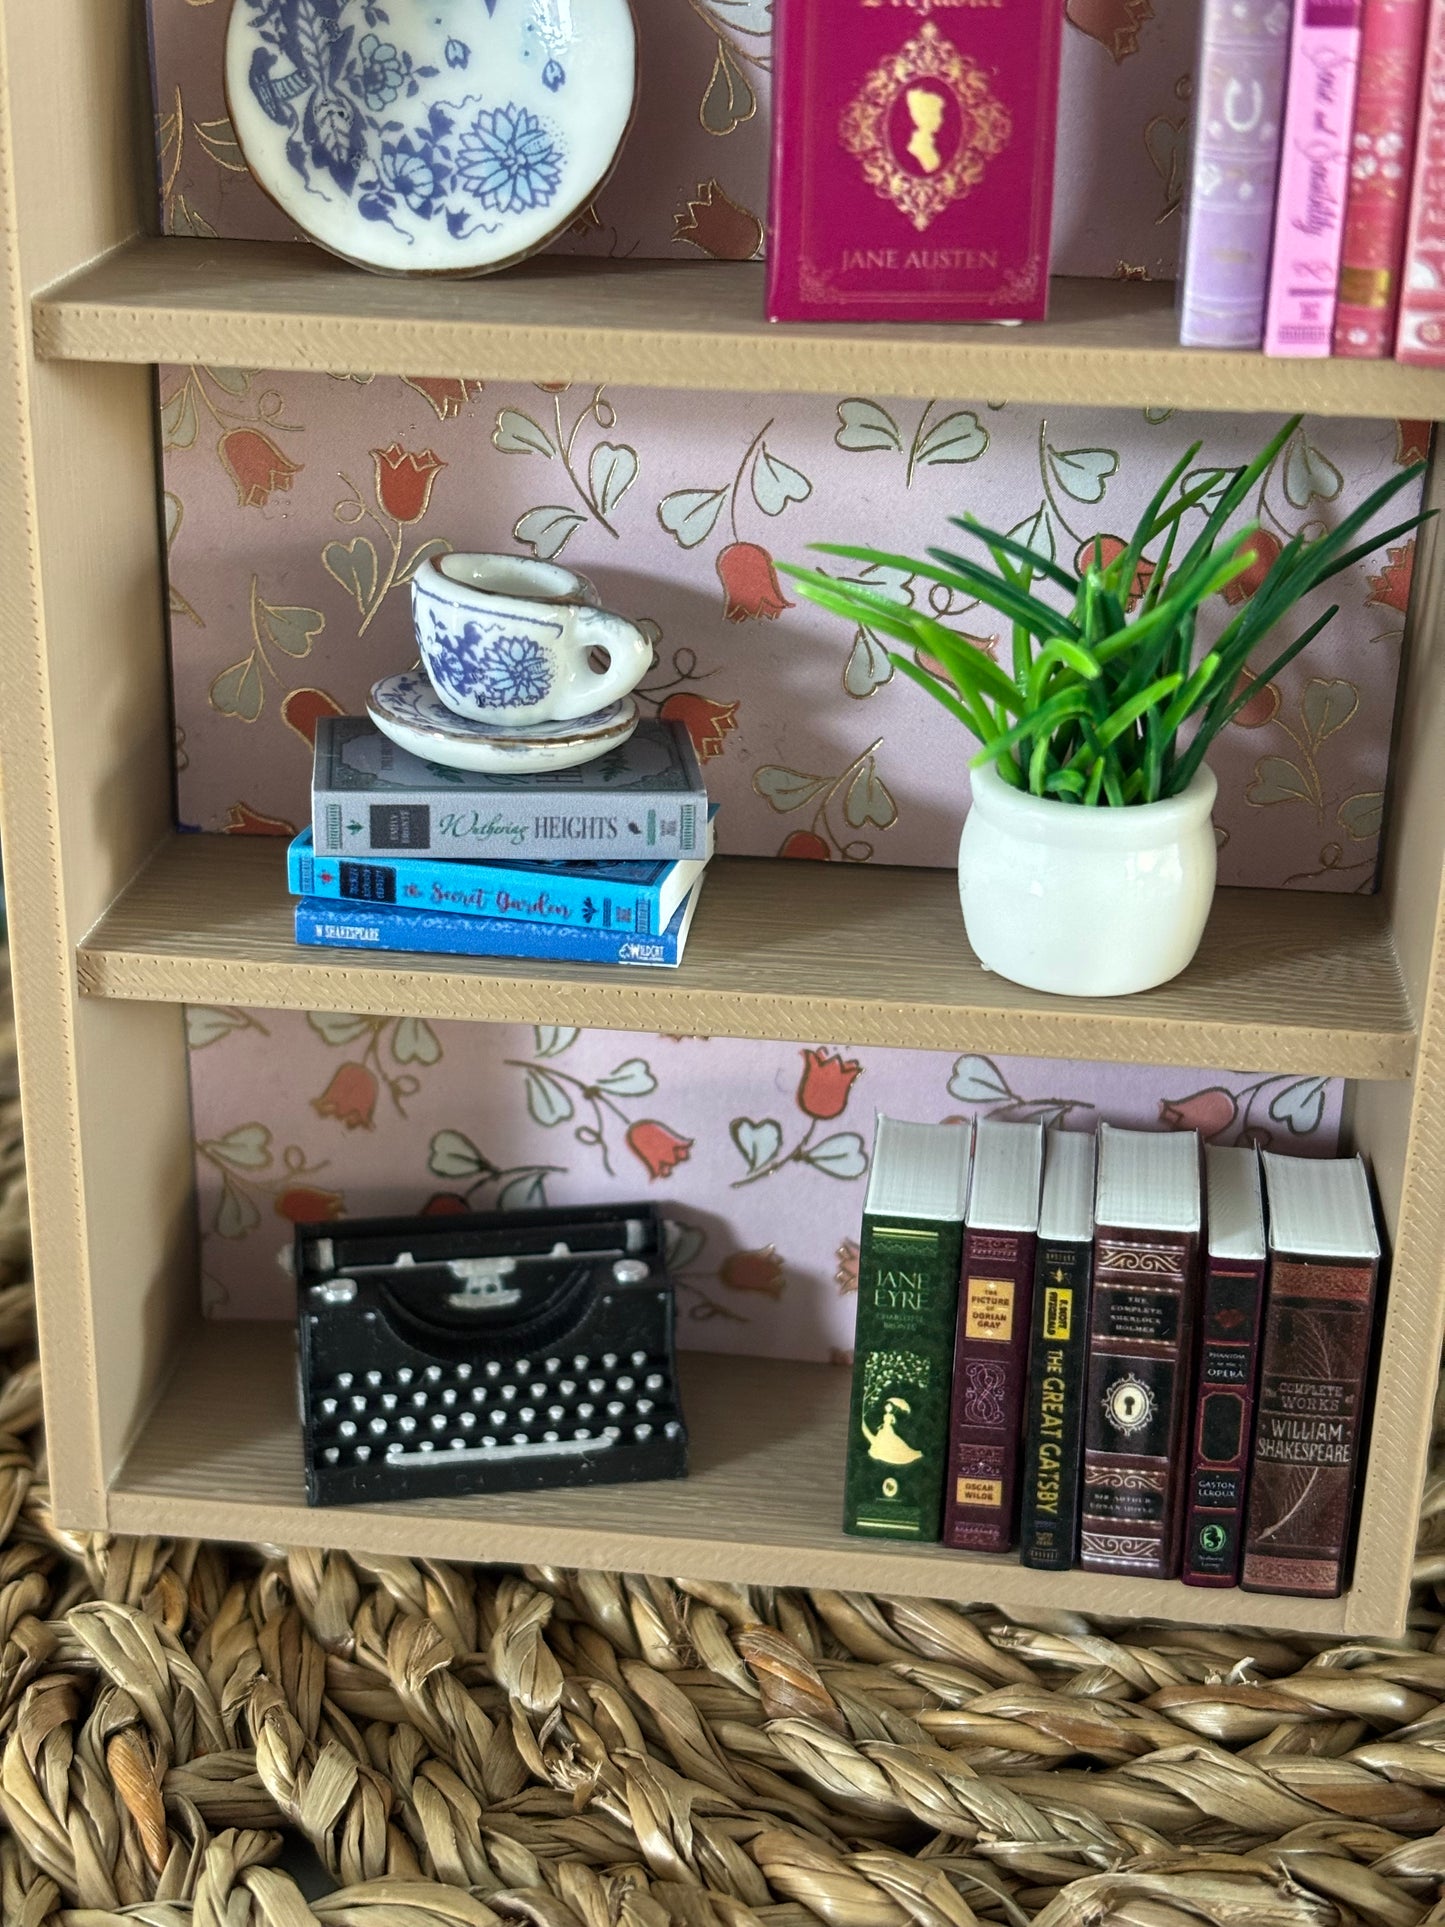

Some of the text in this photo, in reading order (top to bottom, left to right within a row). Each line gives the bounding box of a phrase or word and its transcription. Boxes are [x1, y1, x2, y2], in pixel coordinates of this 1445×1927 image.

[841, 249, 999, 272] JANE AUSTEN
[439, 810, 618, 846] Wuthering HEIGHTS
[324, 925, 381, 942] SHAKESPEARE
[877, 1269, 930, 1290] JANE
[873, 1289, 930, 1311] EYRE
[971, 1295, 1010, 1306] PICTURE
[1128, 1296, 1147, 1304] THE
[1110, 1304, 1163, 1315] COMPLETE
[972, 1311, 1008, 1321] DORIAN
[1110, 1314, 1161, 1325] SHERLOCK
[977, 1319, 1001, 1329] GRAY
[1115, 1324, 1155, 1334] HOLMES
[1208, 1352, 1246, 1360] PHANTOM
[1207, 1368, 1245, 1378] OPERA
[1280, 1382, 1344, 1397] COMPLETE
[1281, 1395, 1341, 1412] WORKS
[1036, 1350, 1065, 1515] THE GREAT GATSBY
[1270, 1418, 1343, 1441] WILLIAM
[1257, 1438, 1352, 1463] SHAKESPEARE
[965, 1482, 994, 1491] OSCAR
[1198, 1480, 1236, 1489] GASTON
[964, 1491, 994, 1501] WILDE
[1198, 1488, 1236, 1498] LEROUX
